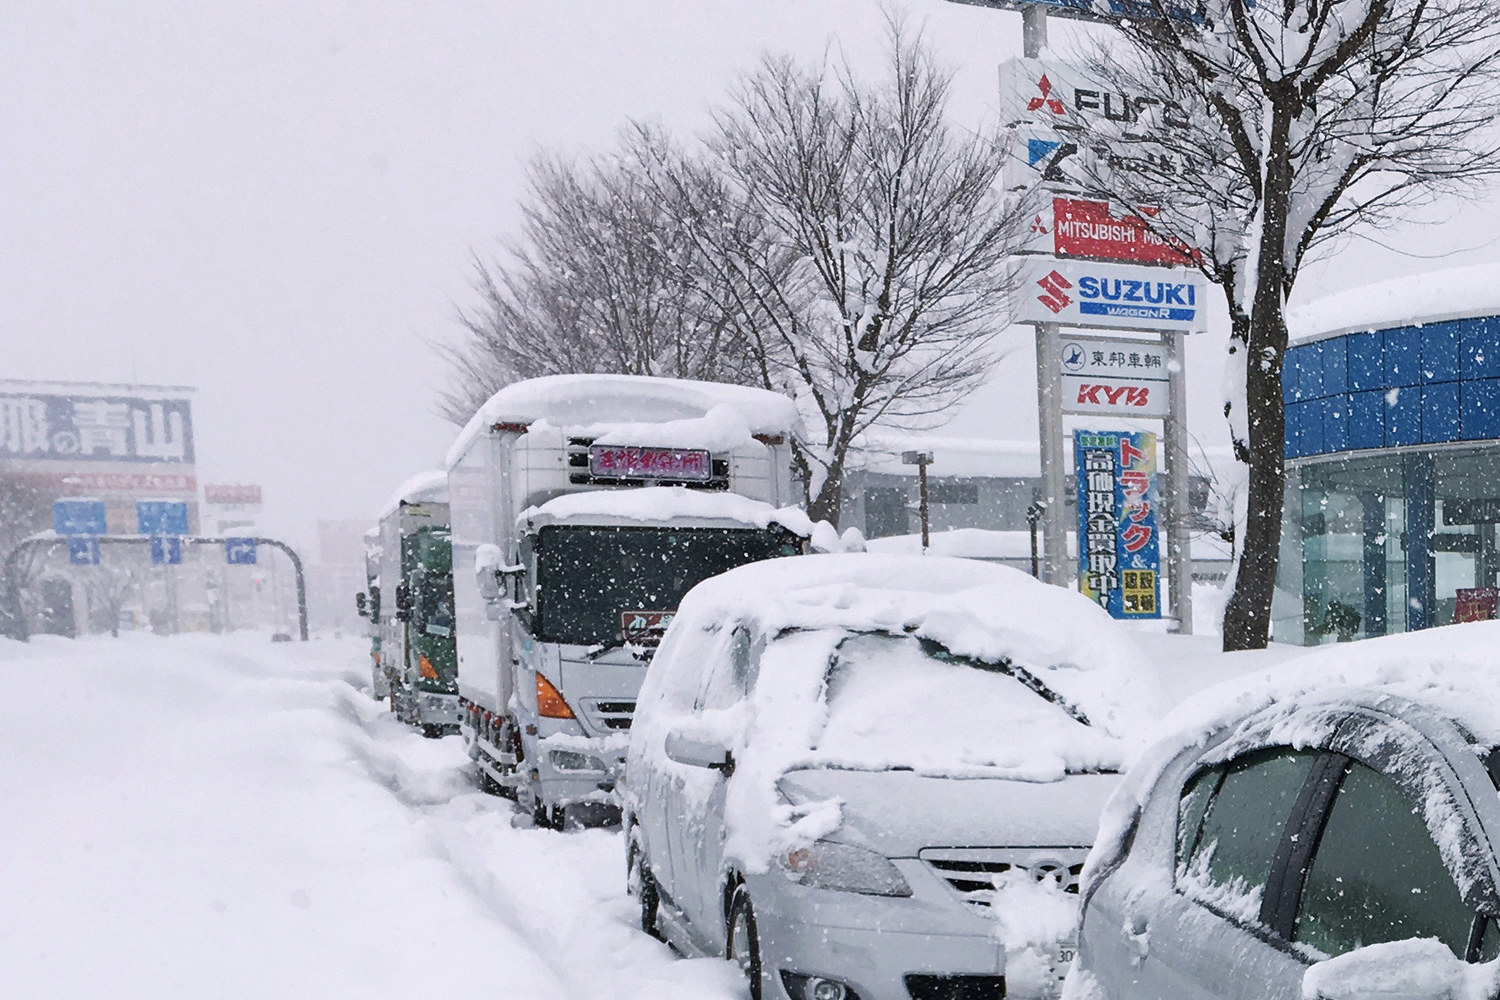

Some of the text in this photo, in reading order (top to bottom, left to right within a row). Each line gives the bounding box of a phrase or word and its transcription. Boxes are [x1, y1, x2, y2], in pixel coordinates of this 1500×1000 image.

[1058, 220, 1136, 243] MITSUBISHI
[1078, 276, 1196, 306] SUZUKI
[1077, 384, 1149, 406] KYB
[1058, 950, 1077, 963] 30
